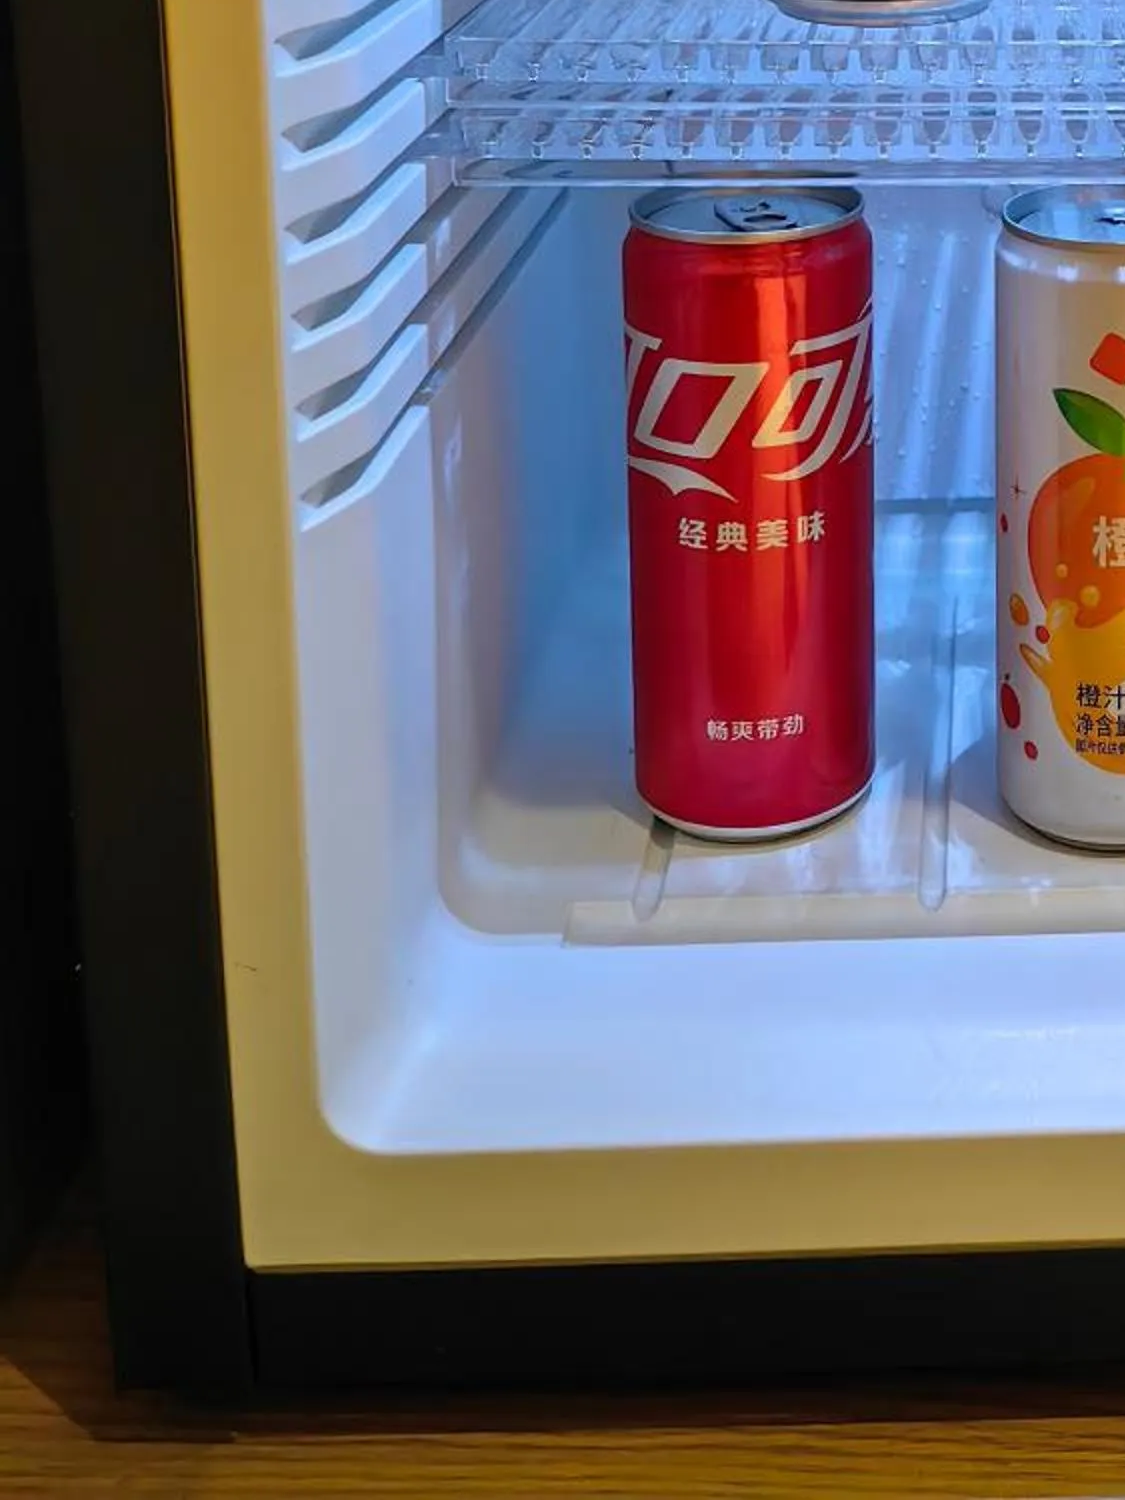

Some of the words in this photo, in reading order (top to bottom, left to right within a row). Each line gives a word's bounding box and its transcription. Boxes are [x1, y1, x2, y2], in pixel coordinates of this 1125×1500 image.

[678, 511, 826, 552] 经典美味
[706, 714, 804, 741] 畅爽带劲
